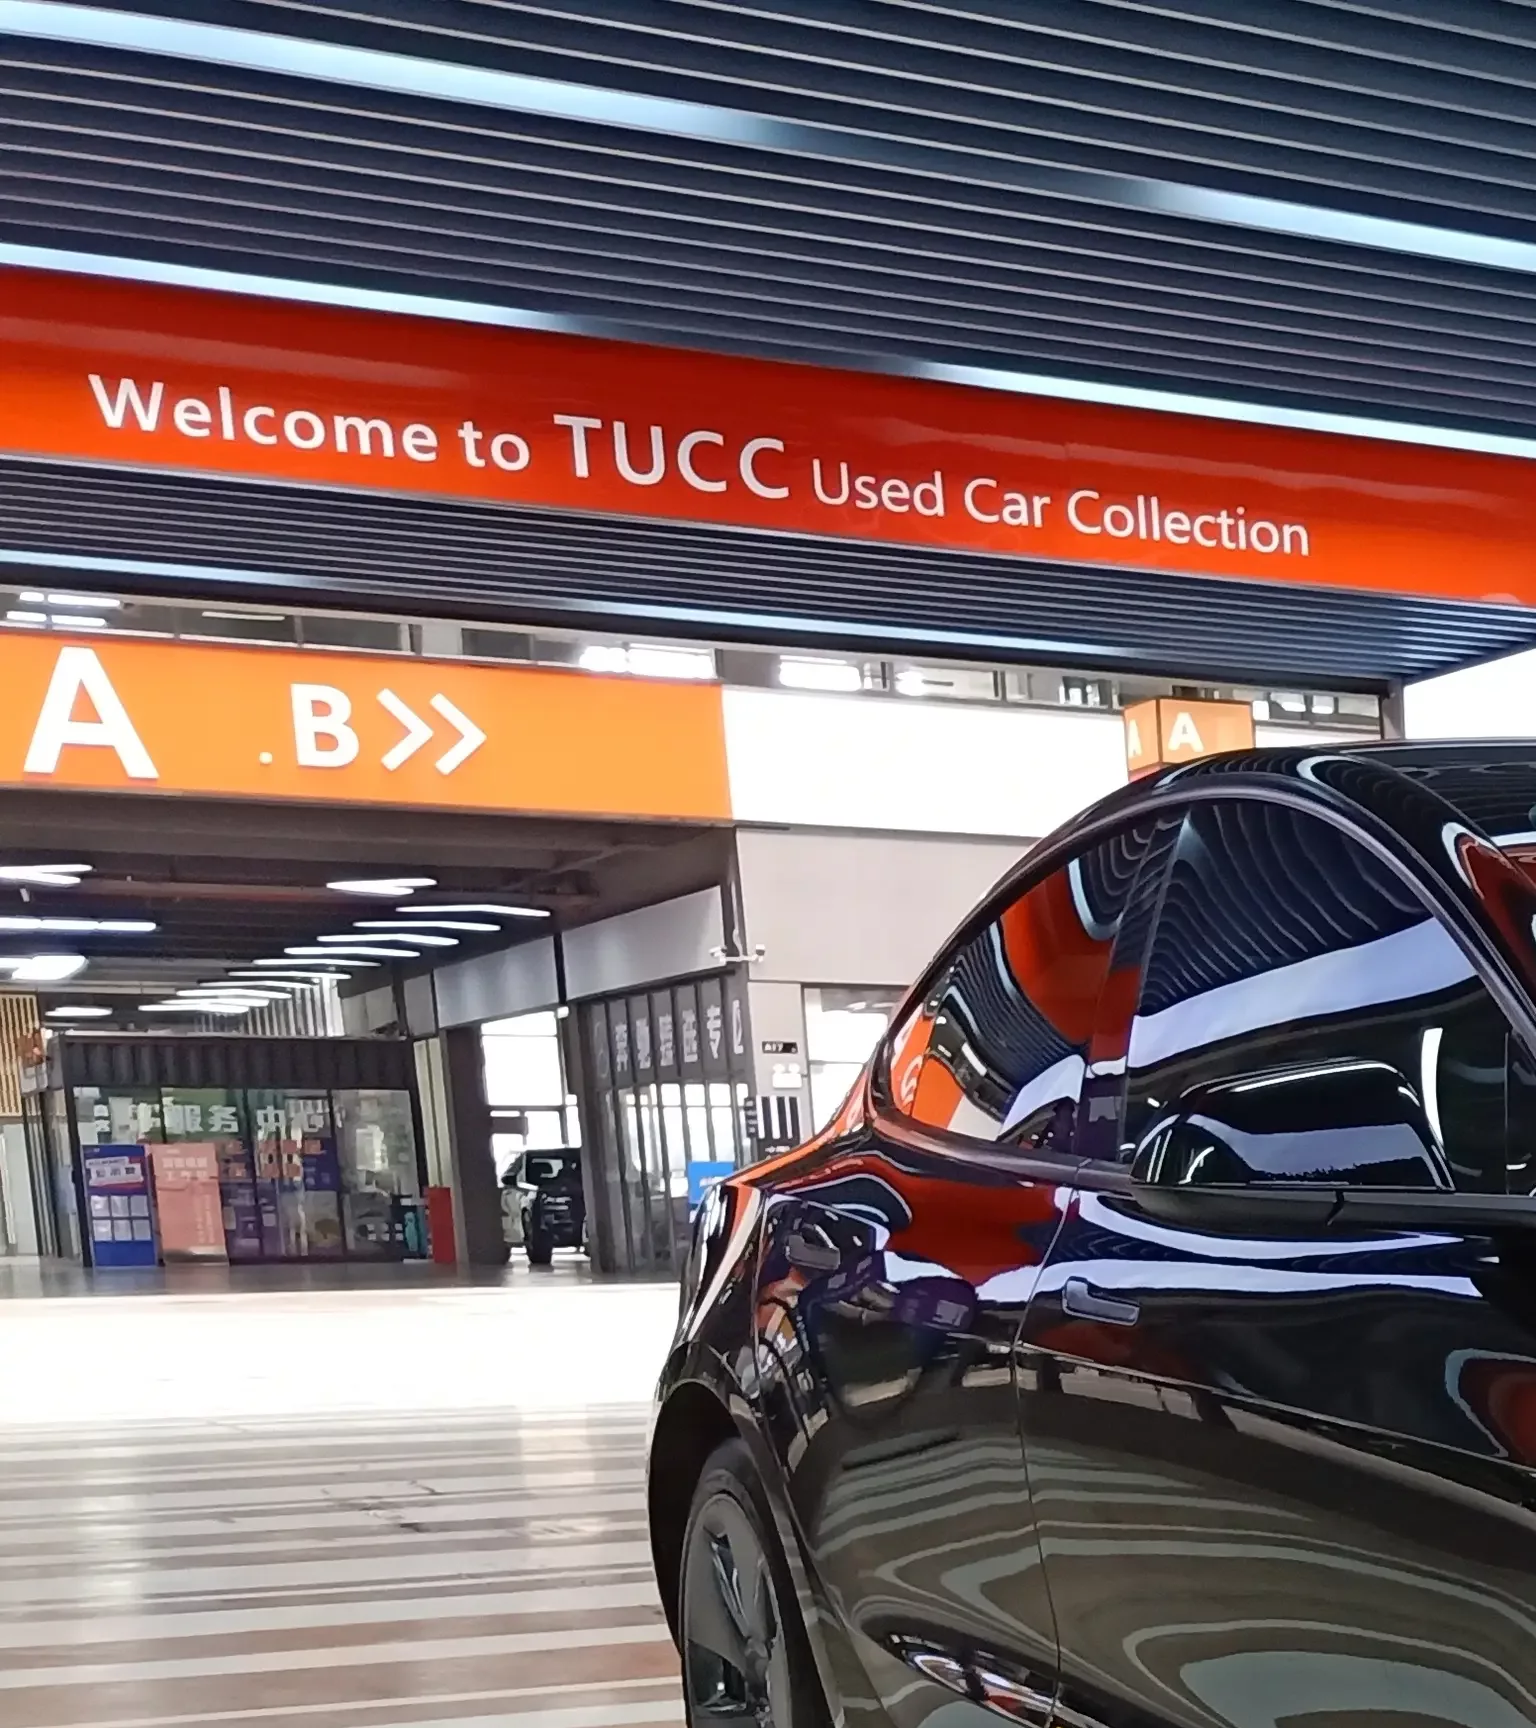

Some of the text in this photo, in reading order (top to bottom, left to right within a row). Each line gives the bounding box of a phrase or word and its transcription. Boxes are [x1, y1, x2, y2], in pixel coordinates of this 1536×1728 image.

[88, 373, 1309, 555] Welcome to TUCC Used Car Collection
[24, 646, 159, 778] A
[1168, 712, 1204, 753] A
